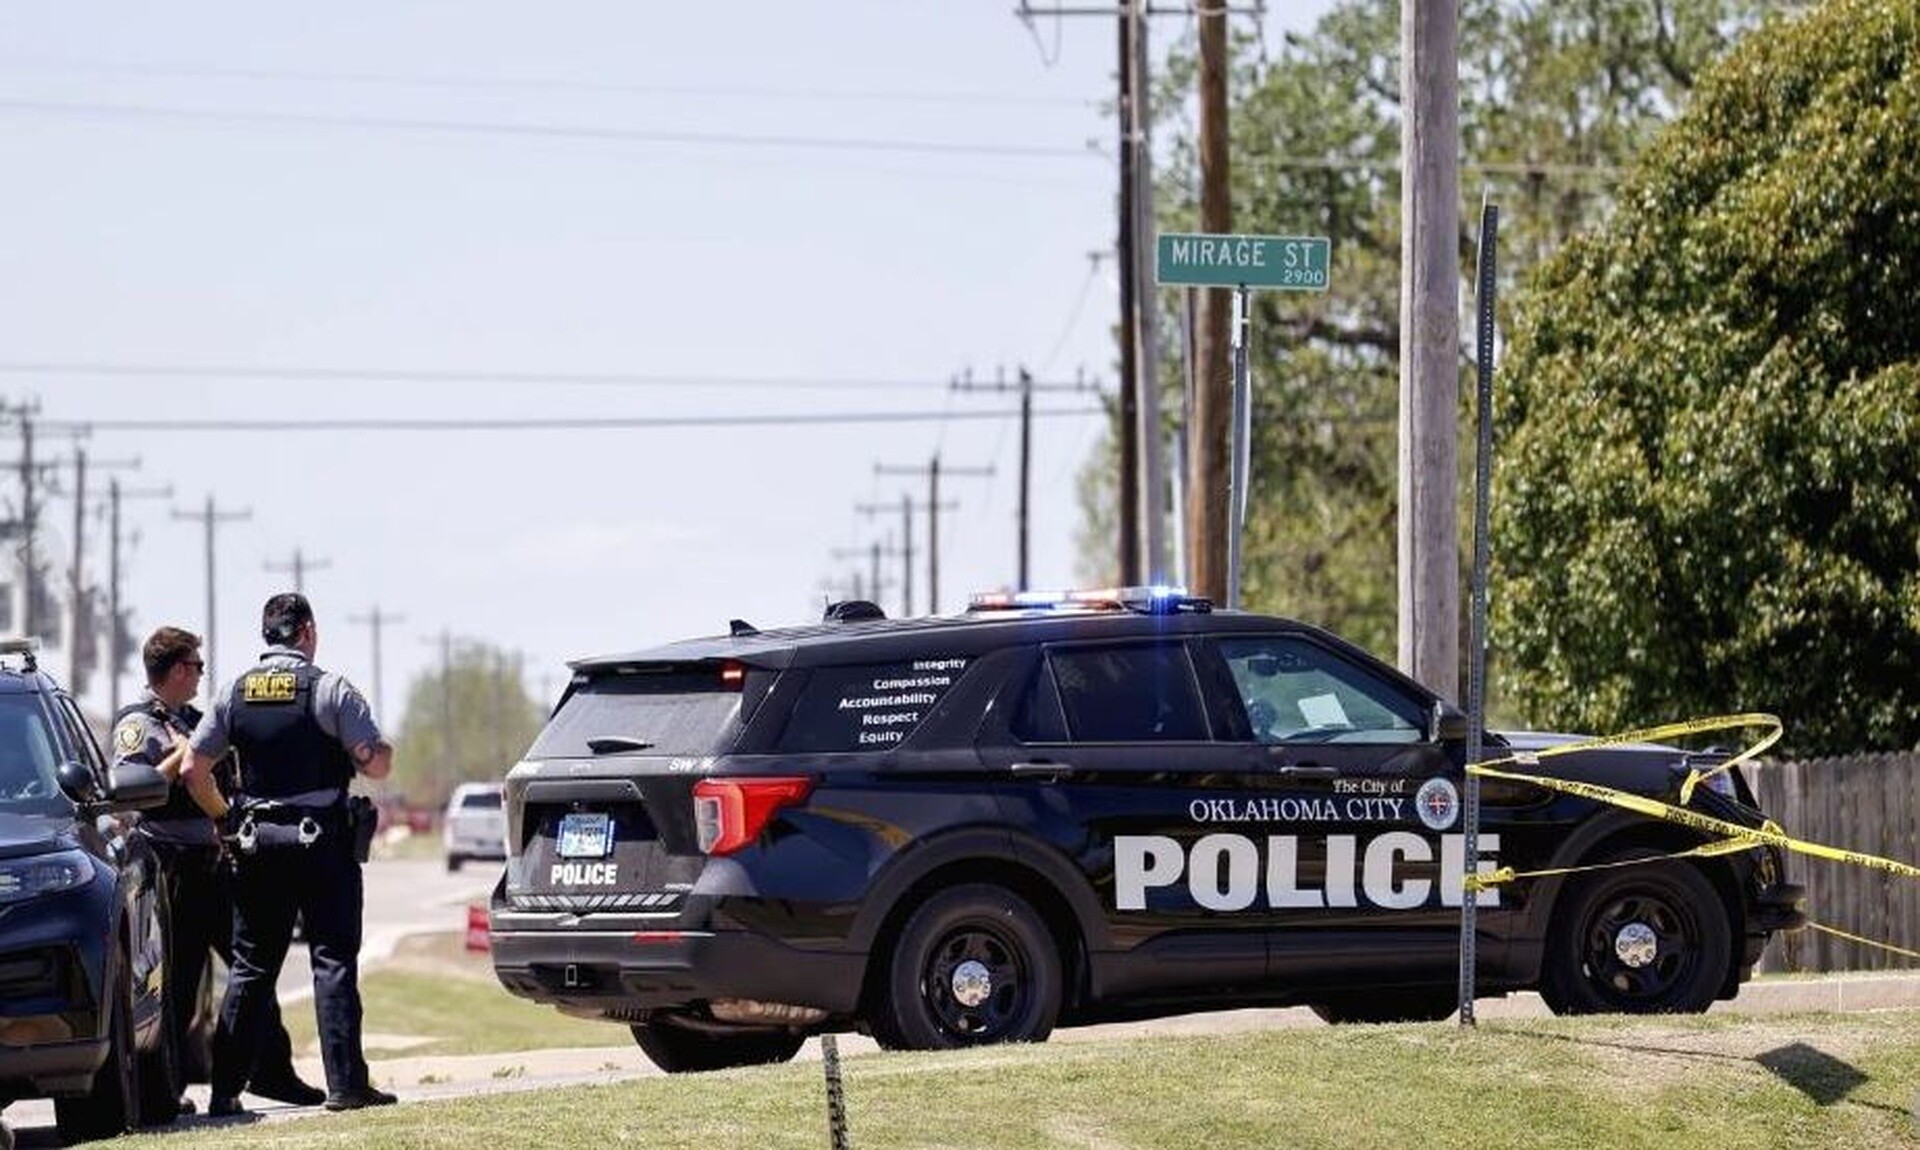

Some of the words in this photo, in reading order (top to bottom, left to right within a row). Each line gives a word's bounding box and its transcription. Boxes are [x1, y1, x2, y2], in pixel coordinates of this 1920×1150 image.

[1172, 239, 1266, 267] MIRAGE
[1284, 242, 1314, 268] ST
[1283, 269, 1323, 284] 2900
[913, 659, 966, 671] Integrity
[248, 675, 293, 698] POLICE
[873, 676, 950, 690] Compassion
[839, 693, 937, 709] Accountability
[862, 712, 919, 726] Respect
[859, 731, 903, 744] Equity
[1333, 779, 1358, 793] The
[1361, 778, 1385, 797] City
[1390, 778, 1405, 793] of
[1189, 798, 1341, 822] OKLAHOMA
[1346, 798, 1404, 820] CITY
[551, 864, 618, 885] POLICE
[1114, 832, 1500, 911] POLICE
